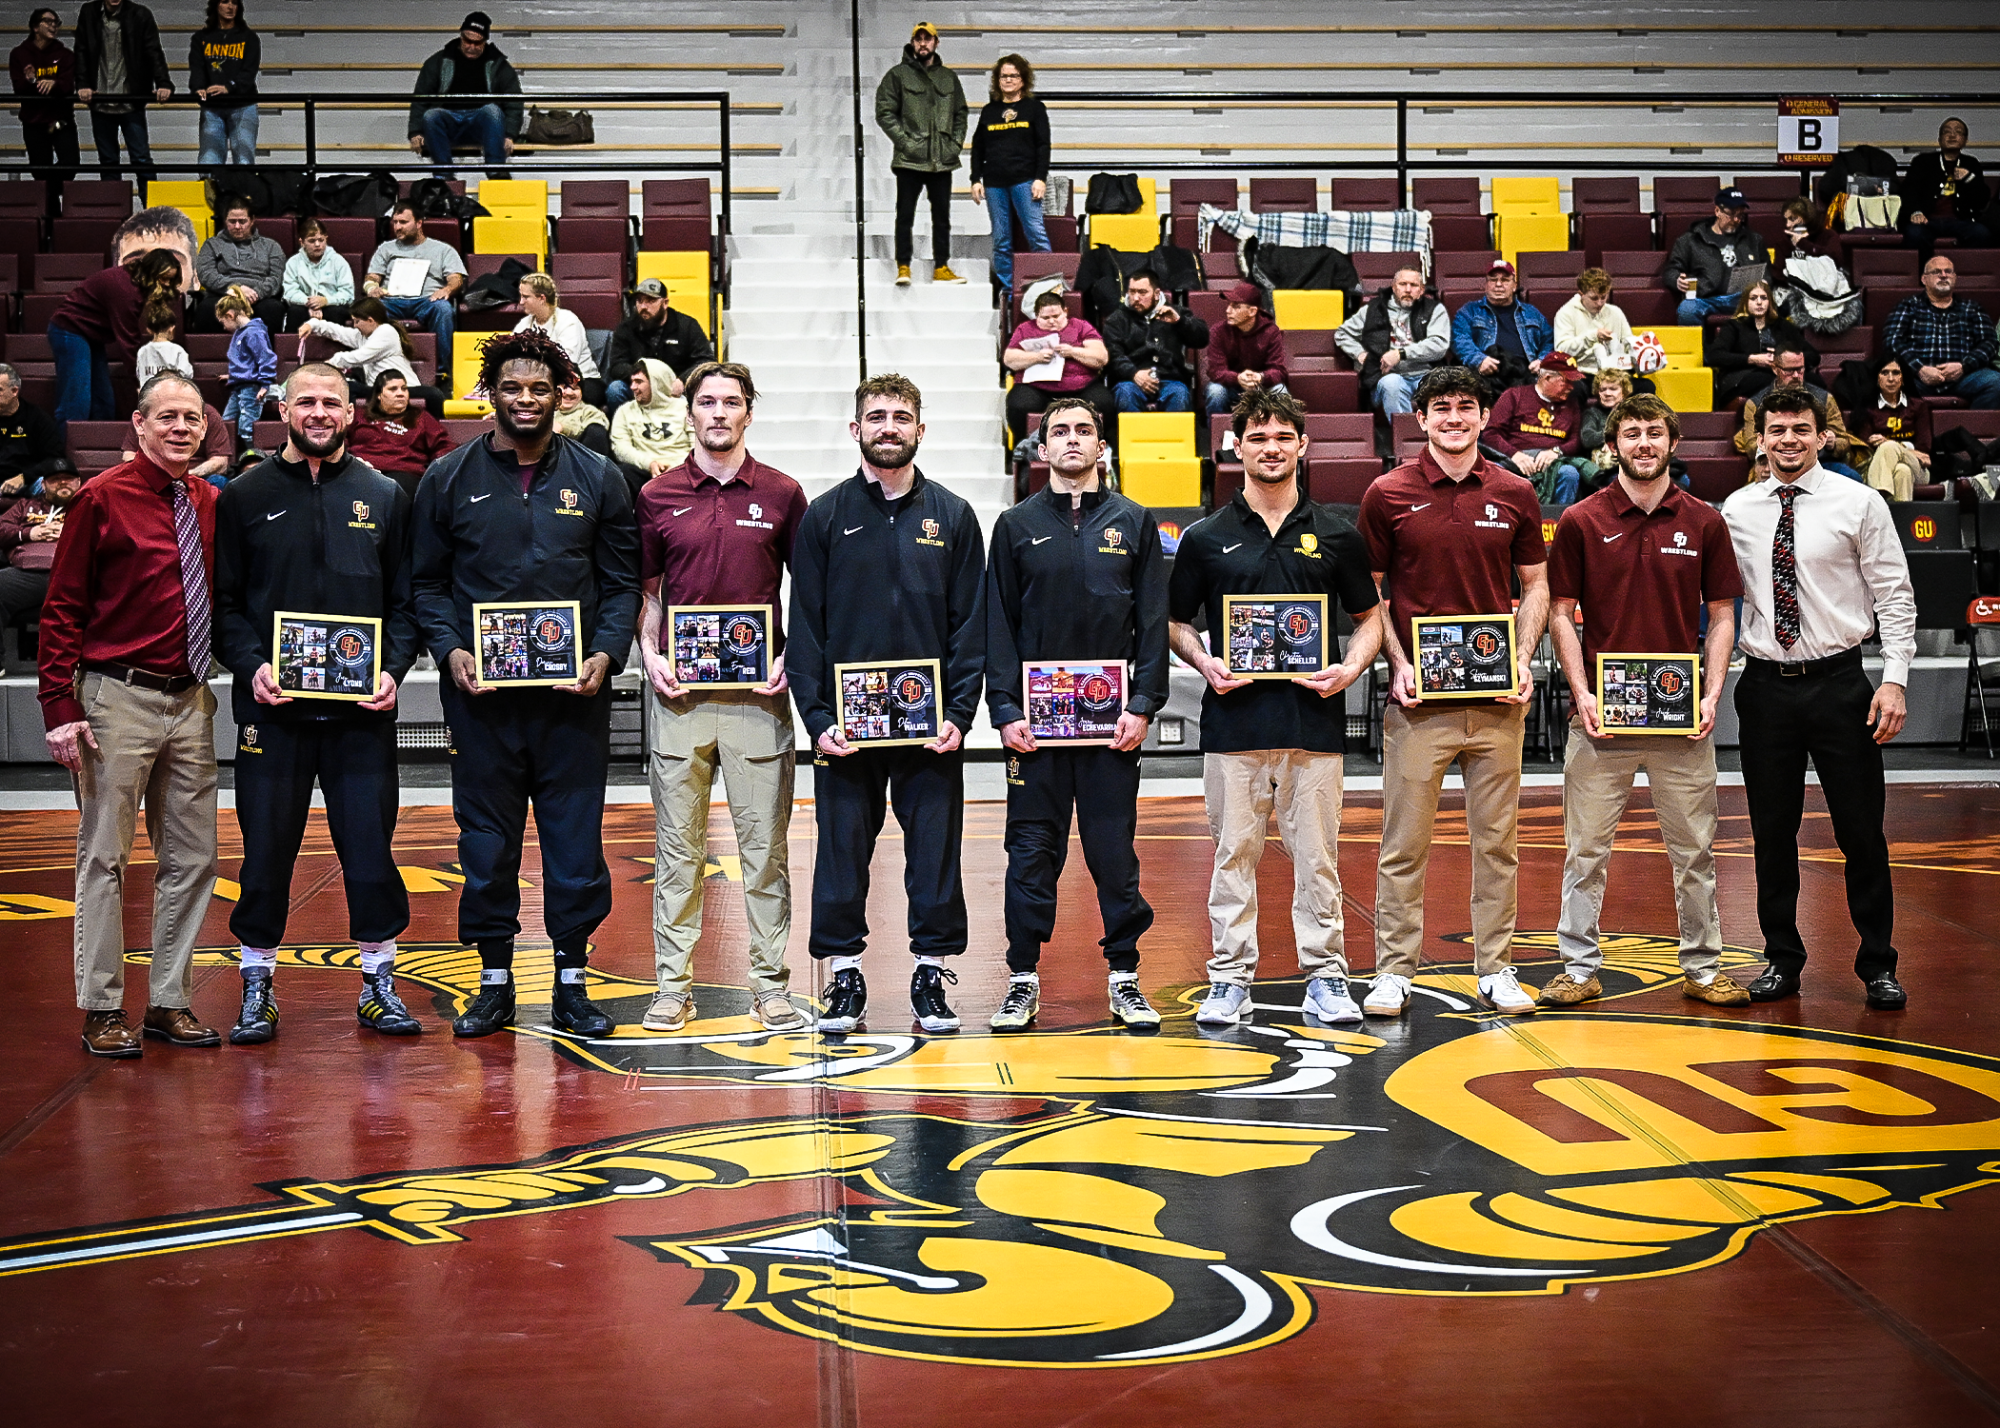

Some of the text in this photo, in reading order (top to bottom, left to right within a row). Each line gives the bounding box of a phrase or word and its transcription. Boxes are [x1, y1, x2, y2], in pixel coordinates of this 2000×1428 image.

[202, 40, 246, 60] ANNON
[1794, 100, 1829, 108] GENERAL
[987, 121, 1030, 132] WRESTLING
[1798, 119, 1822, 151] B
[1792, 154, 1833, 162] RESERVED
[1520, 422, 1566, 438] WRESTLING
[1914, 520, 1933, 539] GU
[1474, 674, 1506, 682] SZYMANSKI
[1664, 714, 1685, 722] WRIGHT
[904, 722, 928, 731] WALKER
[1464, 1058, 2000, 1144] GU
